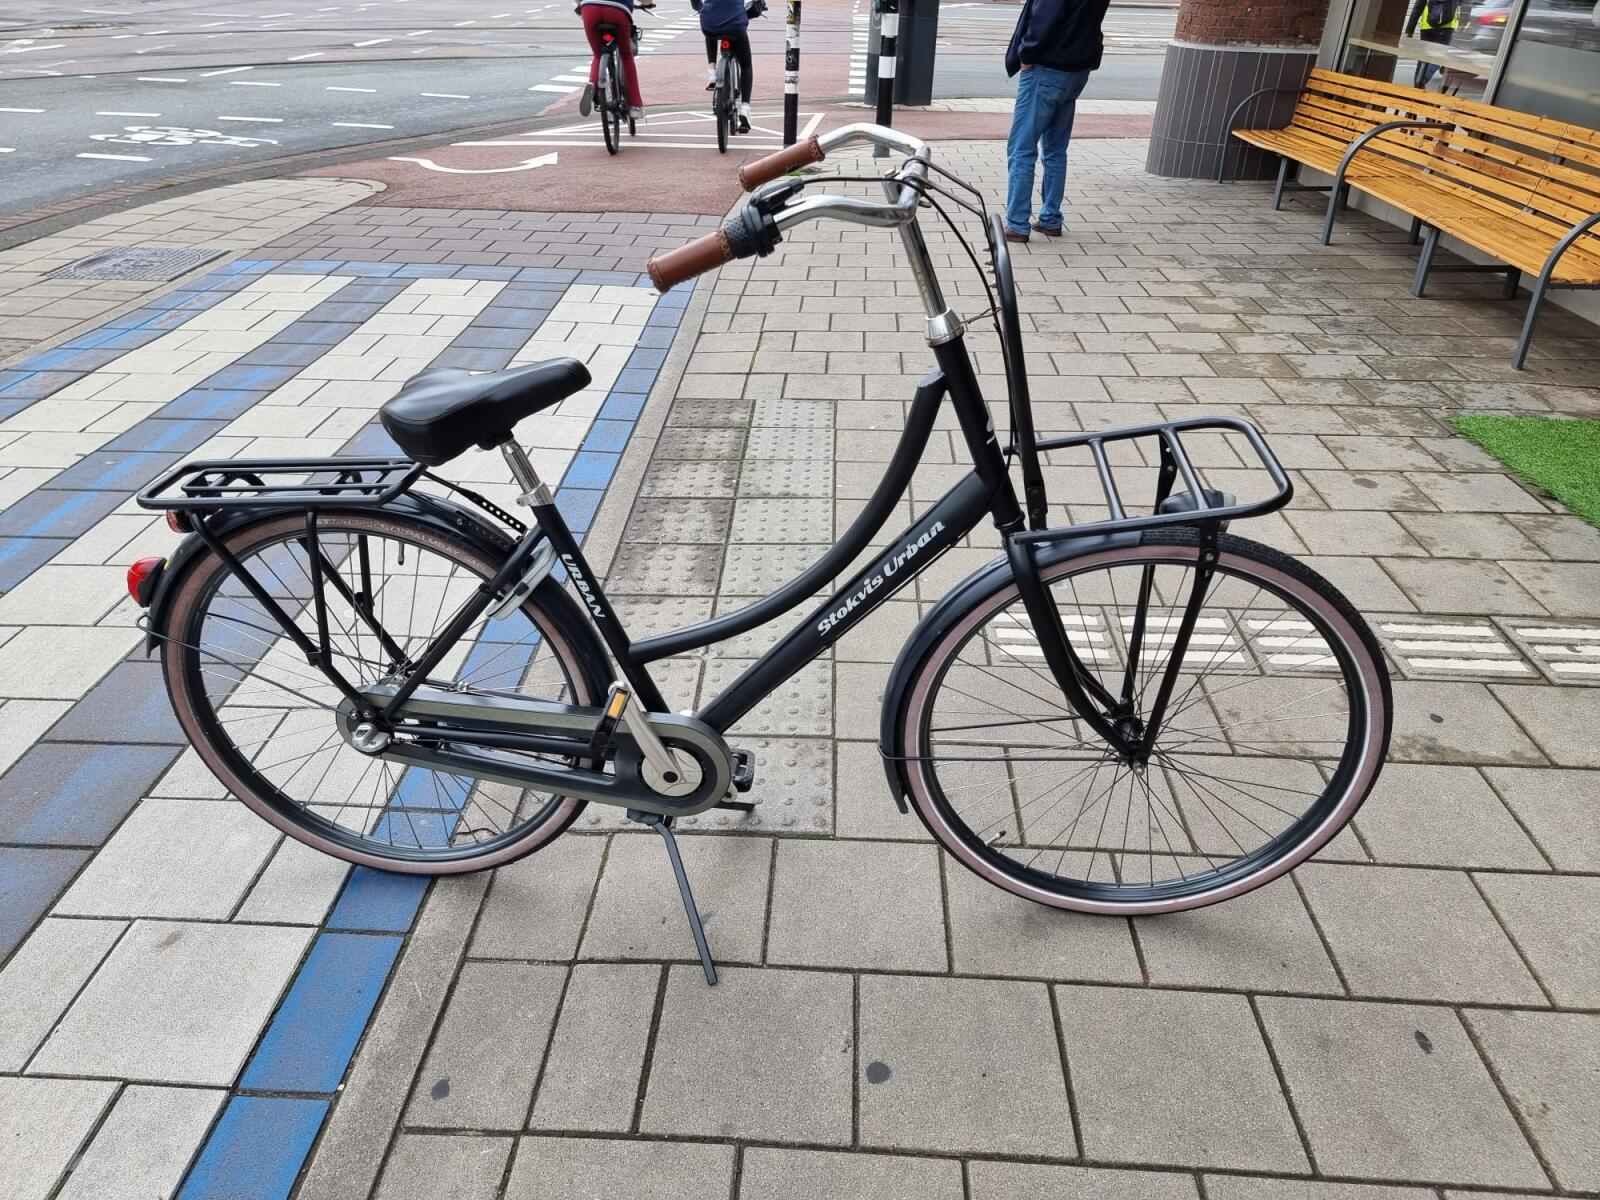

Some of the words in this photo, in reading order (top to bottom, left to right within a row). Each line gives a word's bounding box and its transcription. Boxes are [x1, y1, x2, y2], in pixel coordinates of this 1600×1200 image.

[561, 553, 606, 618] URBAN
[817, 574, 884, 637] Stokvis
[883, 521, 946, 577] Urban
